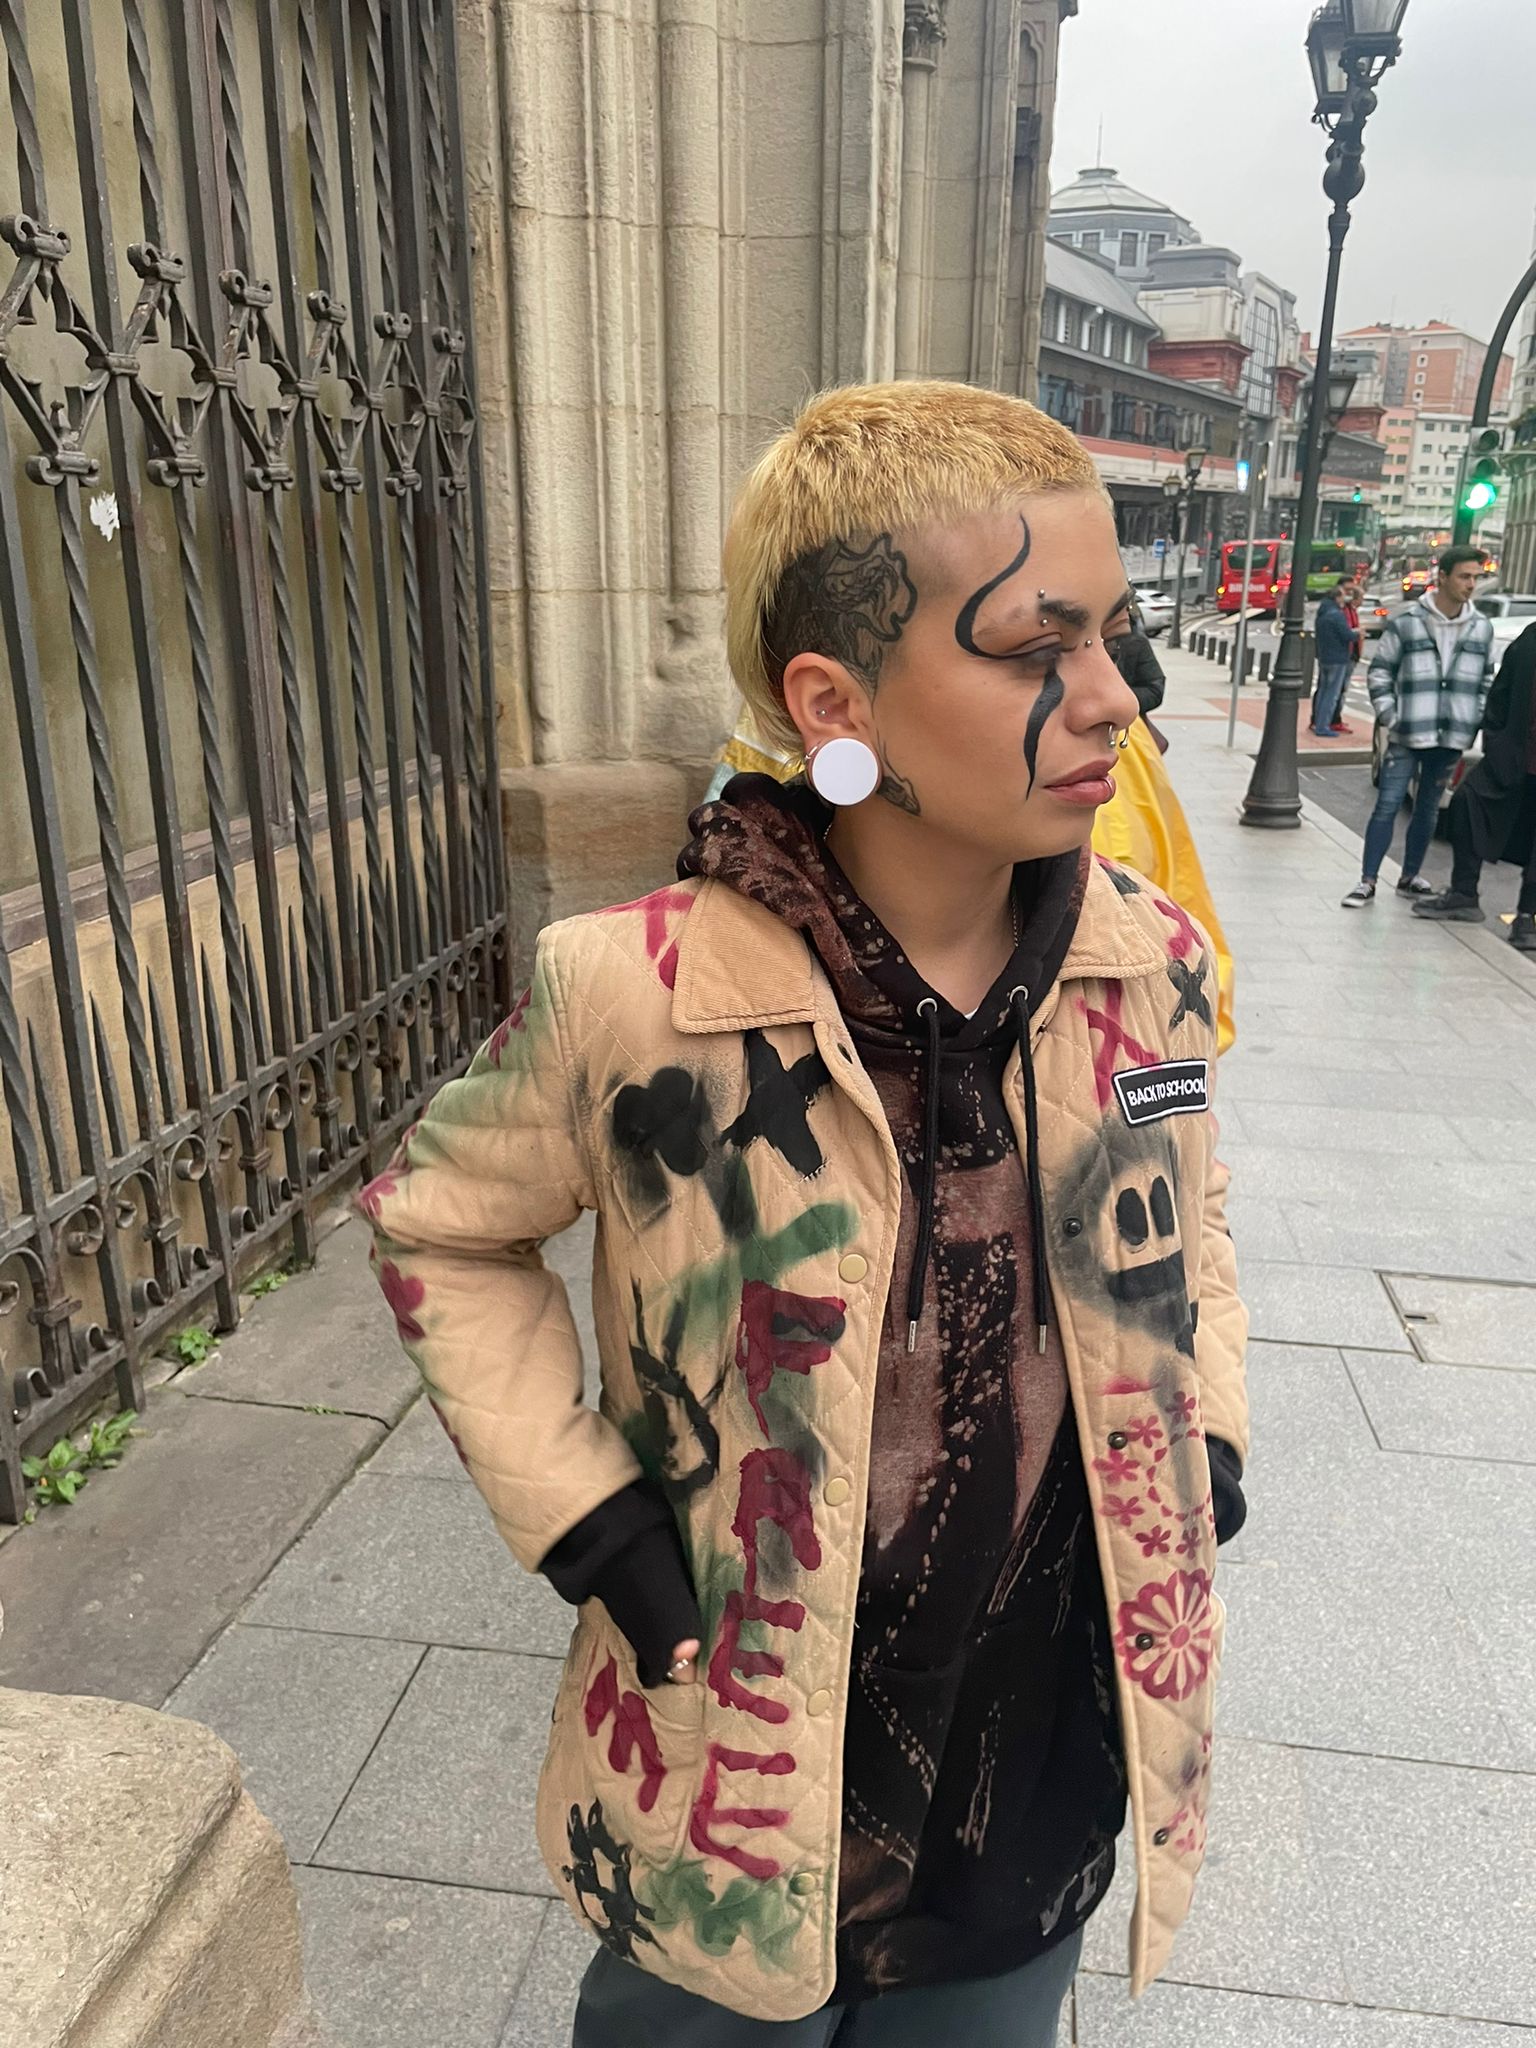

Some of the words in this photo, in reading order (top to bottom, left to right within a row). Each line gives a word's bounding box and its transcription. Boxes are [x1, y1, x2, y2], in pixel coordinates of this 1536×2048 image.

[1127, 1084, 1157, 1106] BACK
[1156, 1082, 1166, 1100] TO
[1166, 1077, 1206, 1097] SCHOOL
